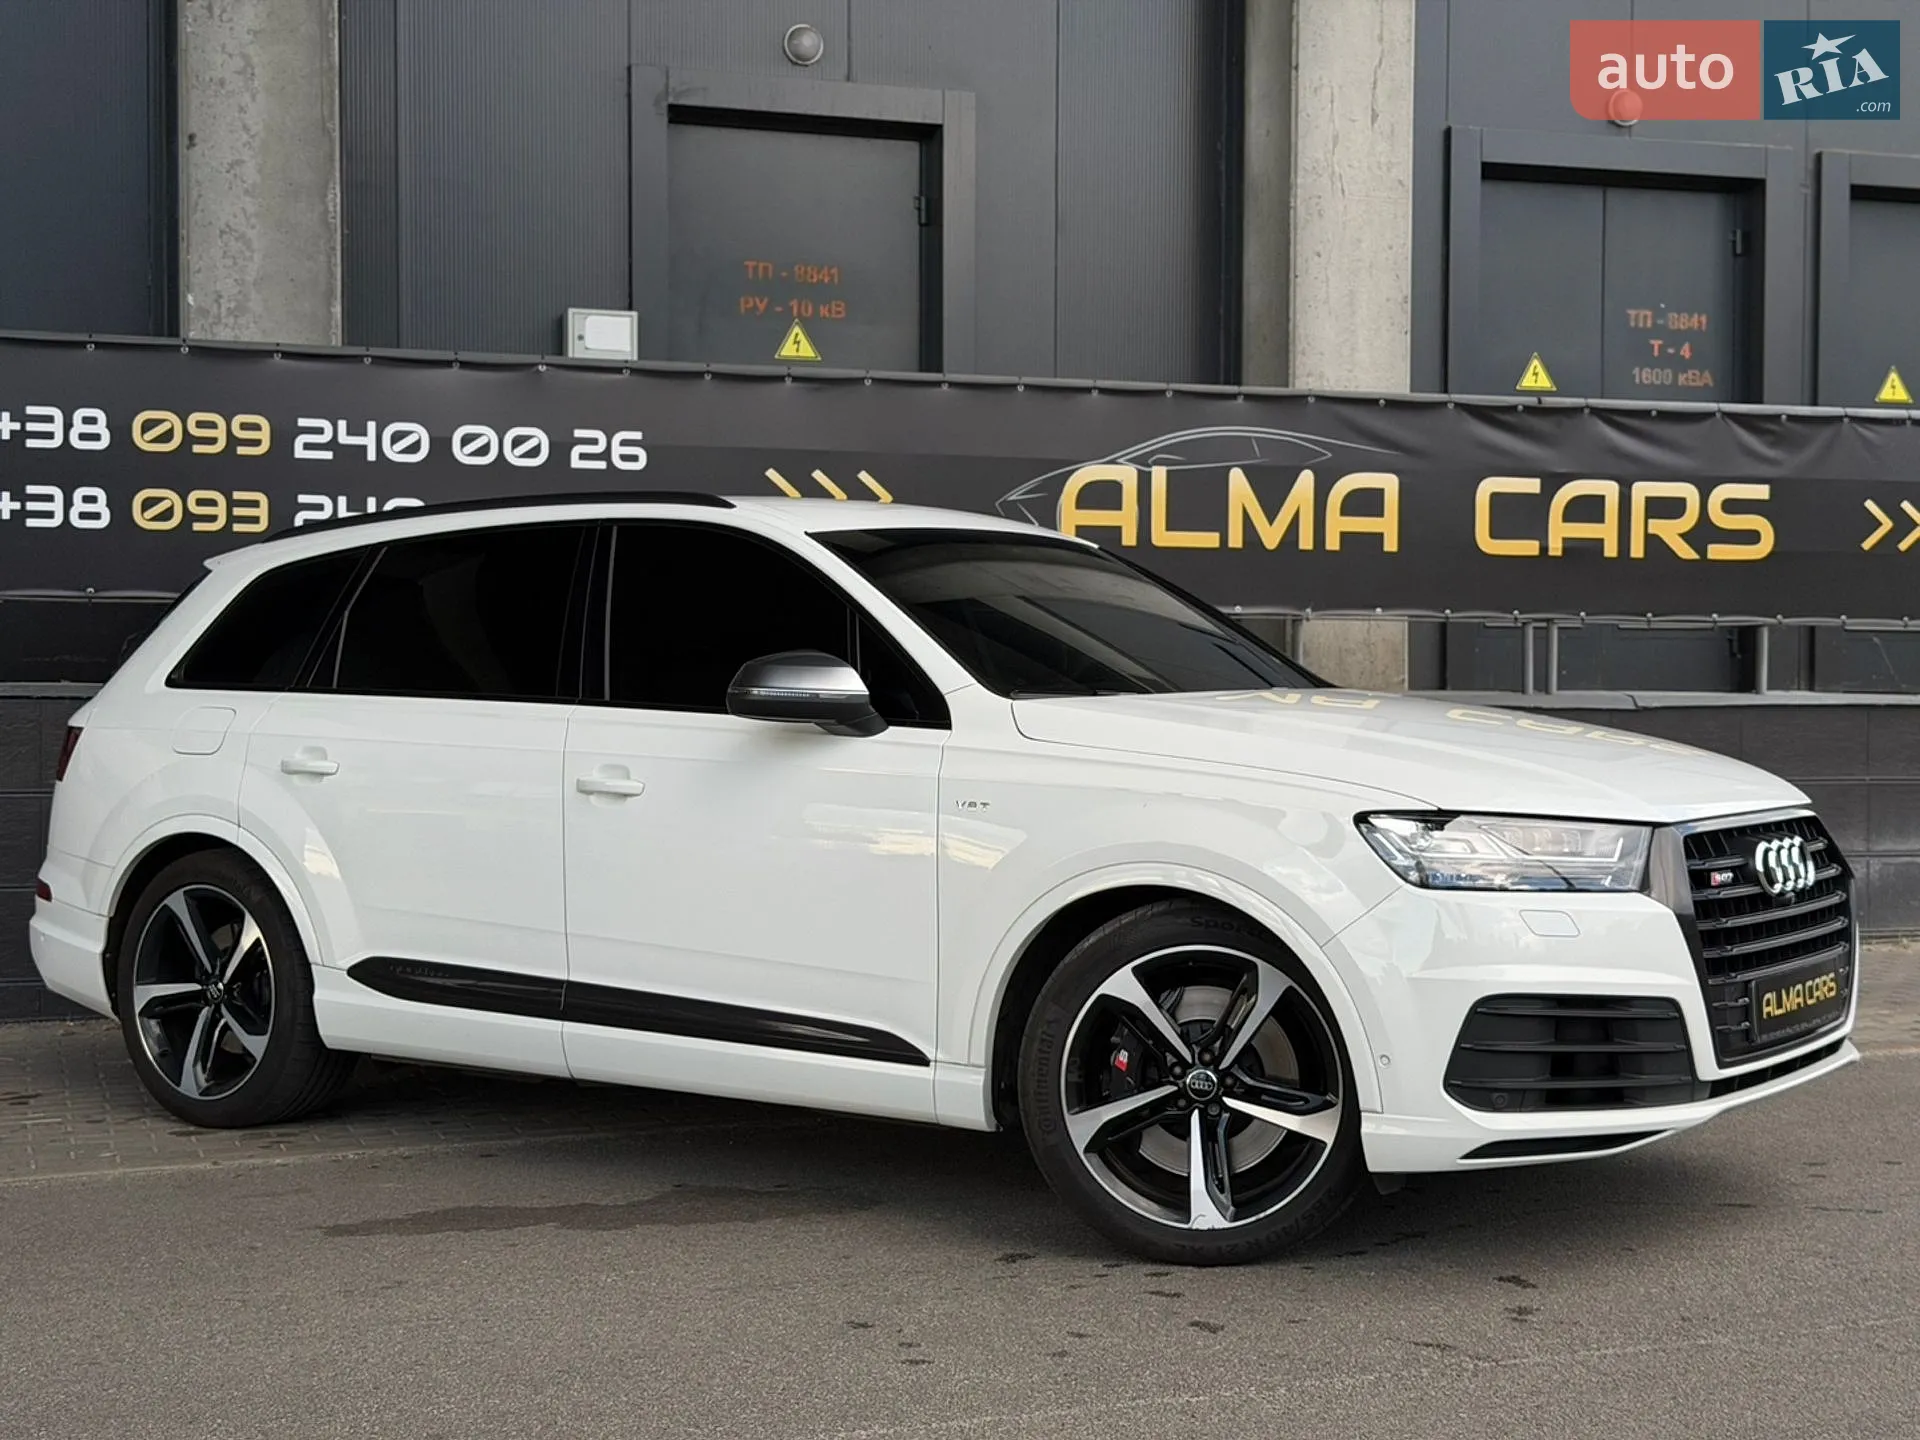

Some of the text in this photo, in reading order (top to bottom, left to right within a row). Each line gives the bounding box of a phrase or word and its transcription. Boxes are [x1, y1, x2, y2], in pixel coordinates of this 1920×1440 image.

[743, 260, 774, 281] ТП
[794, 264, 839, 285] 8841
[739, 296, 768, 316] РУ
[789, 298, 813, 317] 10
[819, 301, 847, 319] кВ
[1627, 309, 1652, 328] ТП
[1679, 341, 1692, 359] 4
[1631, 366, 1713, 386] 1600 кВА
[0, 405, 648, 470] +38 099 240 00 26
[0, 484, 111, 530] +38
[132, 488, 269, 534] 093
[1058, 462, 1777, 560] ALMA CARS
[1762, 972, 1837, 1020] ALMA CARS
